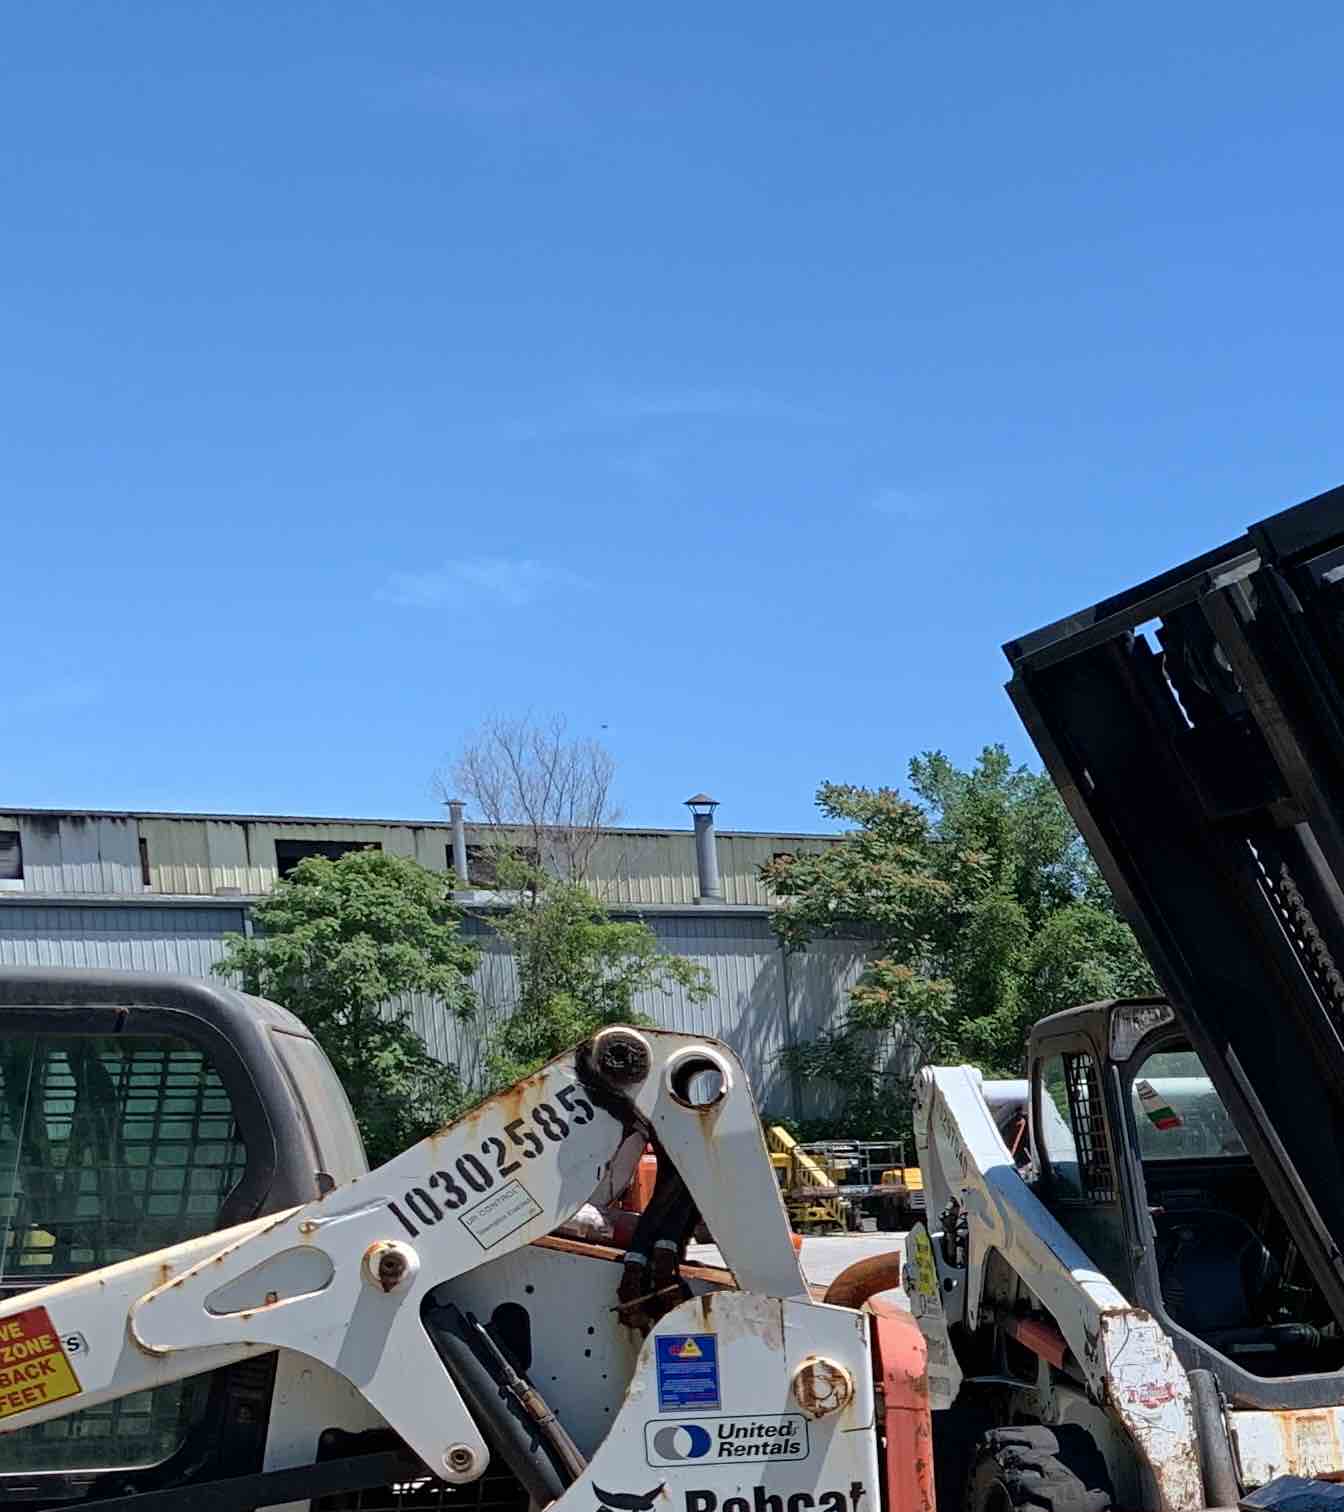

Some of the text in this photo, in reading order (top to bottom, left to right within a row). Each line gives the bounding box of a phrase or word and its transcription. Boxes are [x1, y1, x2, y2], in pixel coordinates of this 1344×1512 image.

[387, 1084, 595, 1239] 10302585
[3, 1334, 54, 1363] ZONE
[0, 1358, 57, 1387] BACK
[717, 1420, 793, 1440] United
[717, 1438, 801, 1458] Rentals
